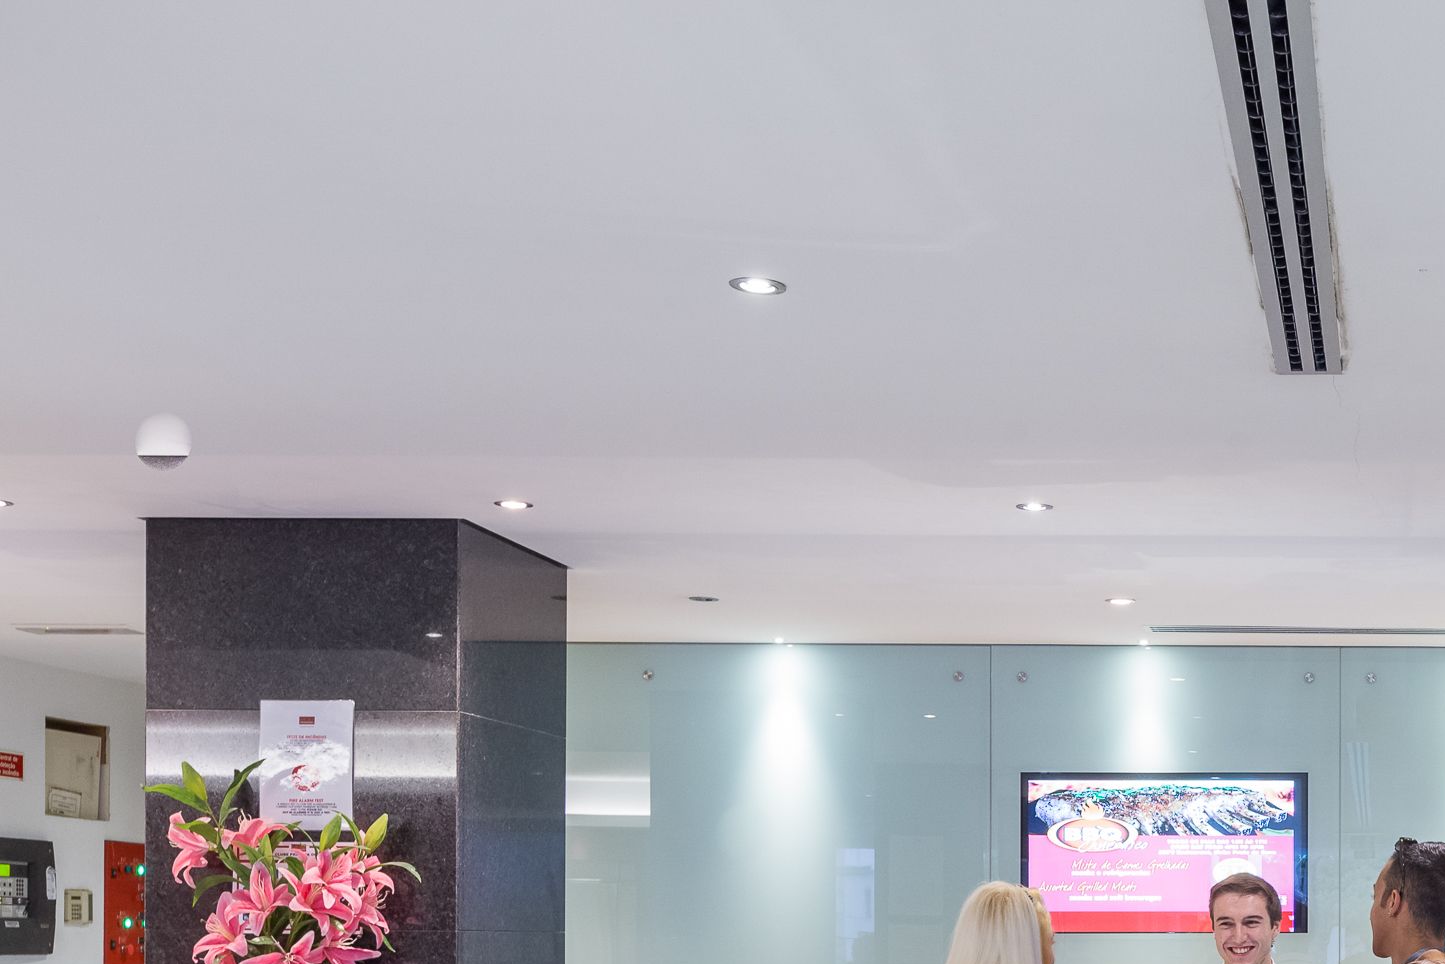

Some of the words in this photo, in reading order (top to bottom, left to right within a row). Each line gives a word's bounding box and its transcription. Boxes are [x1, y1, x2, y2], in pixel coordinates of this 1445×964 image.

[1102, 860, 1110, 869] de
[1039, 882, 1073, 891] Assorted
[1078, 882, 1107, 895] Grilled
